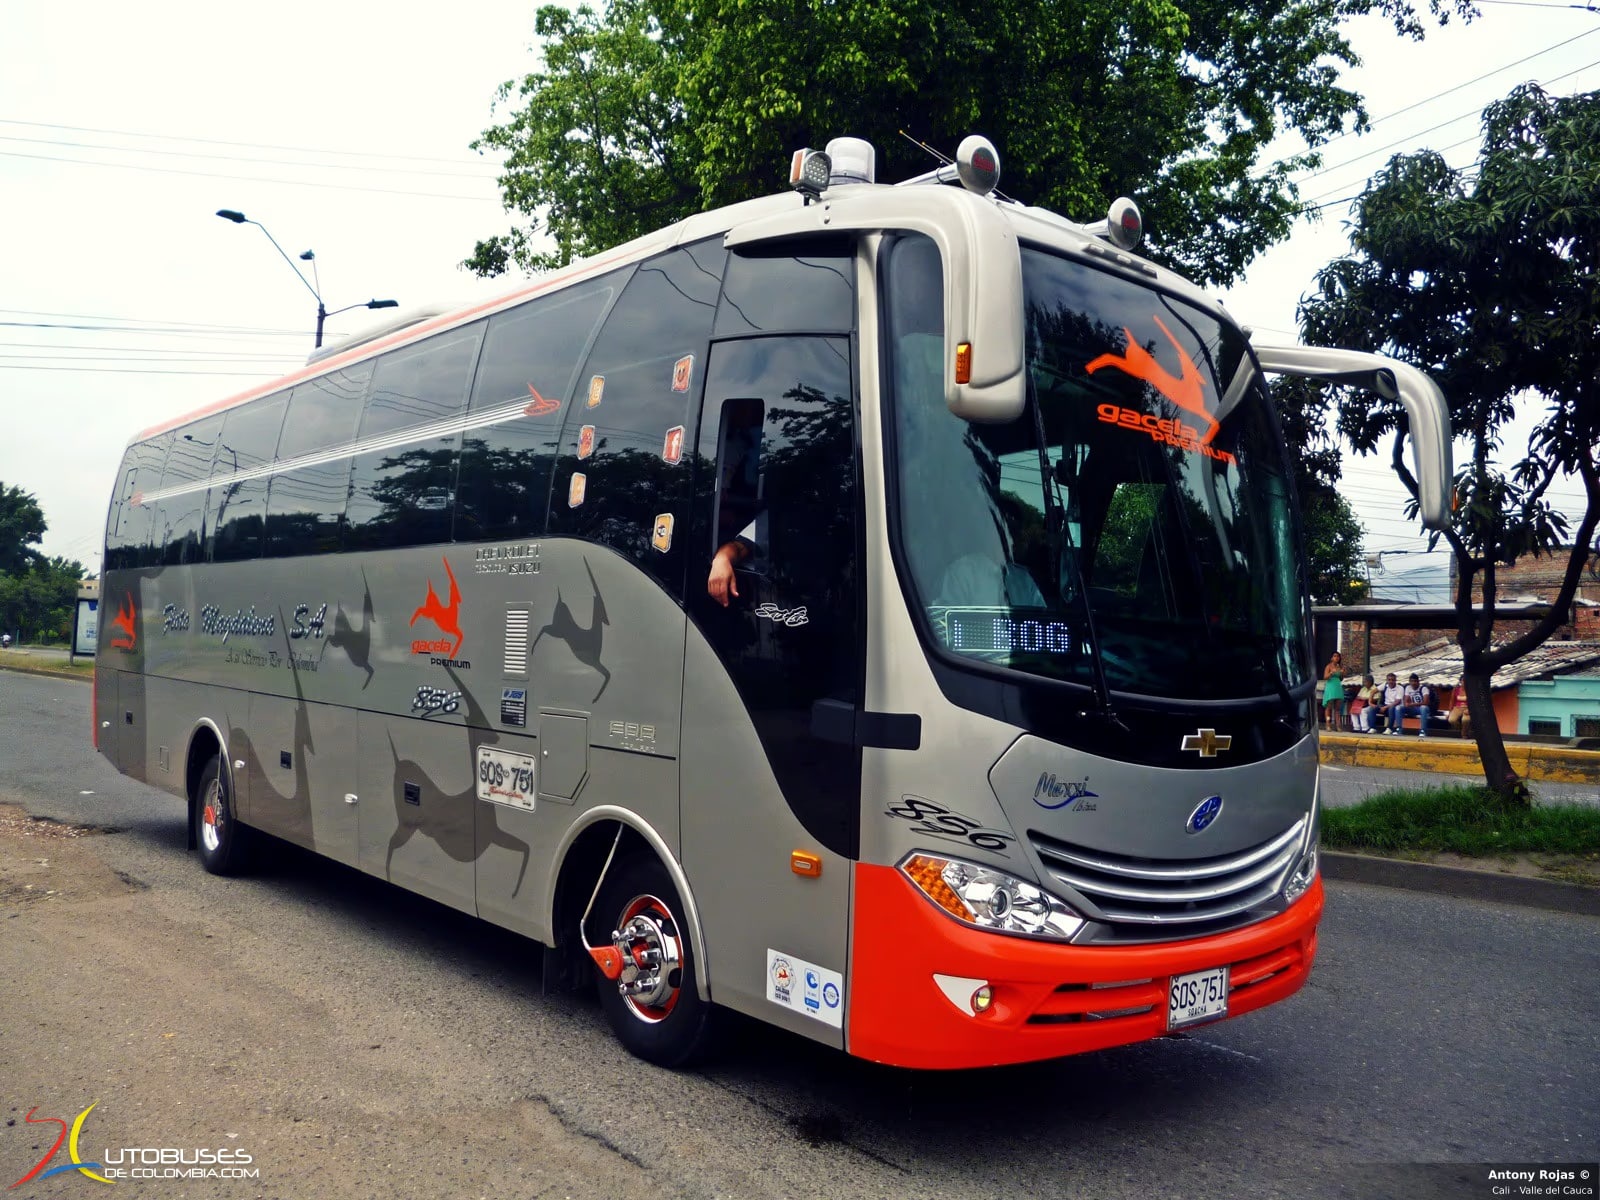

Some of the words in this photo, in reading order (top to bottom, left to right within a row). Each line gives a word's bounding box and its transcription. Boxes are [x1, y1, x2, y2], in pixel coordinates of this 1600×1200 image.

[1097, 403, 1199, 443] gacela
[509, 561, 541, 575] ISUZU
[411, 638, 452, 655] gacela
[430, 657, 471, 670] PREMIUM
[1034, 771, 1090, 798] Maxxi
